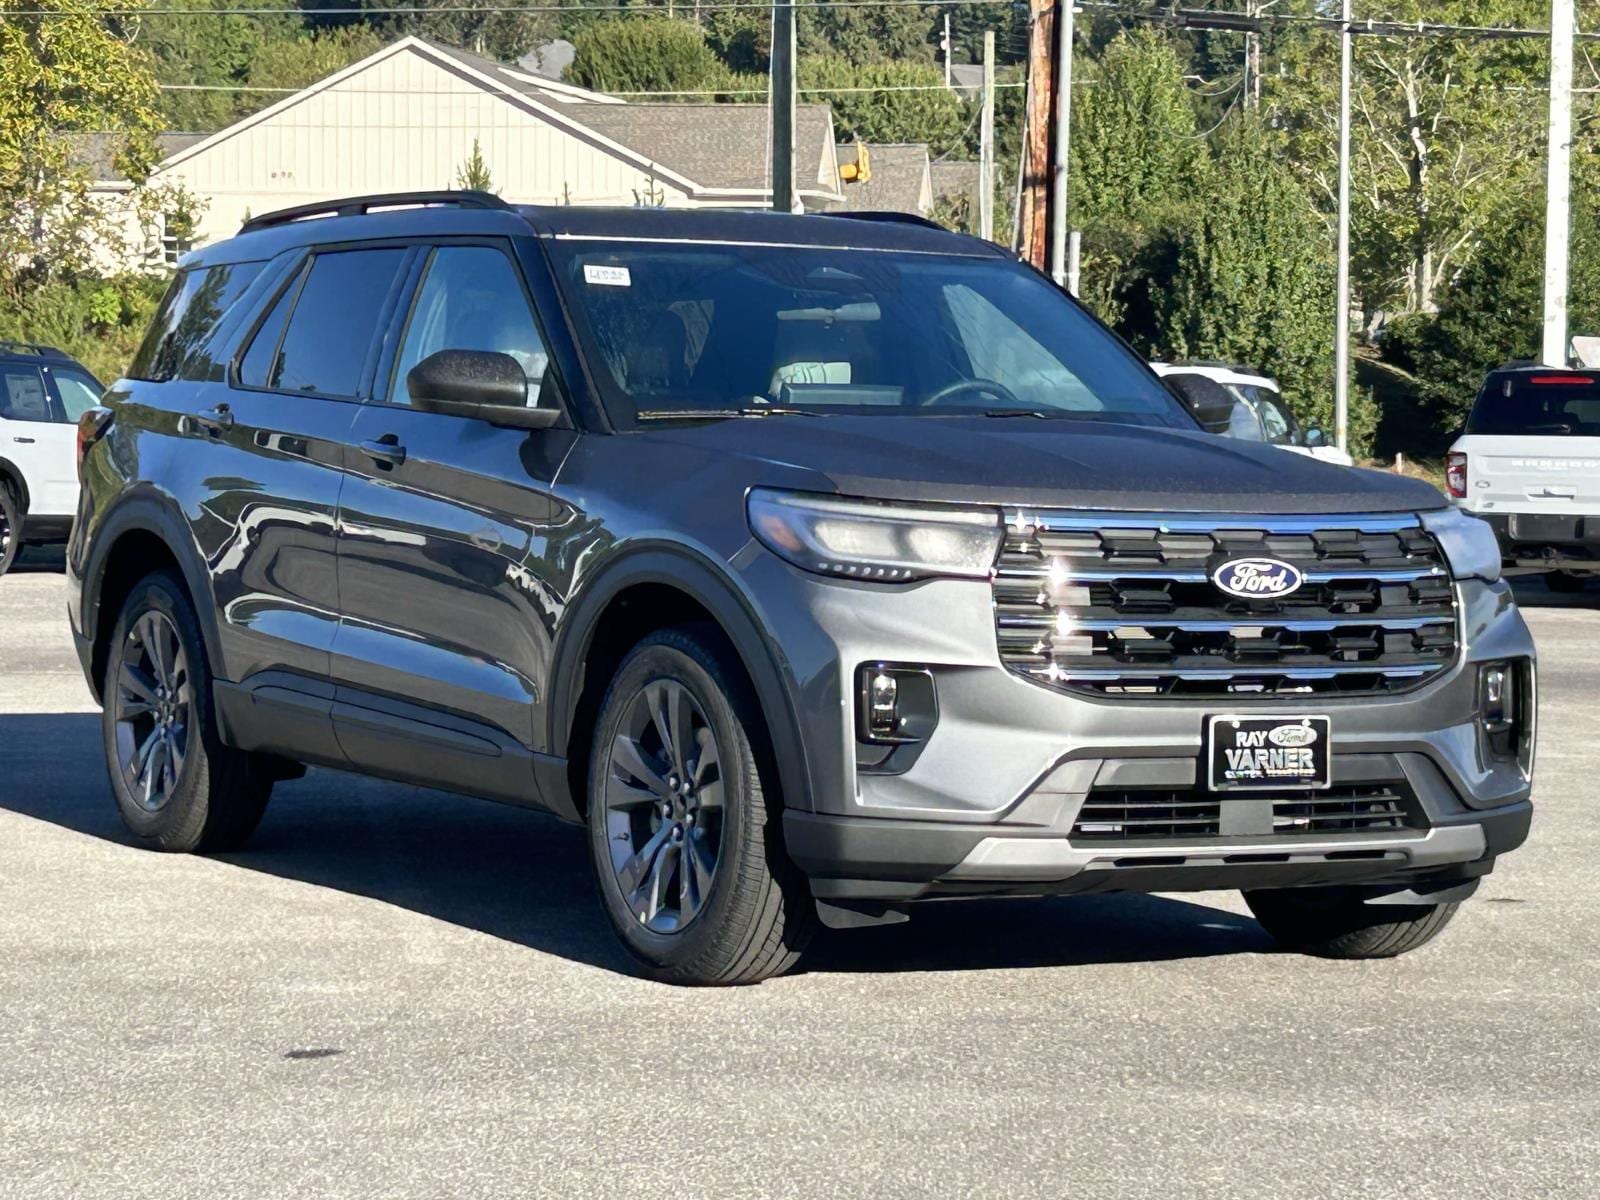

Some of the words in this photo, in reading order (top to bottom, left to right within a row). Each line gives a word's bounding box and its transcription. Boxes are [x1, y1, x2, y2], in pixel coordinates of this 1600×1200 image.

[1230, 562, 1288, 592] Ford
[1235, 731, 1267, 747] RAY
[1225, 748, 1314, 769] VARNER
